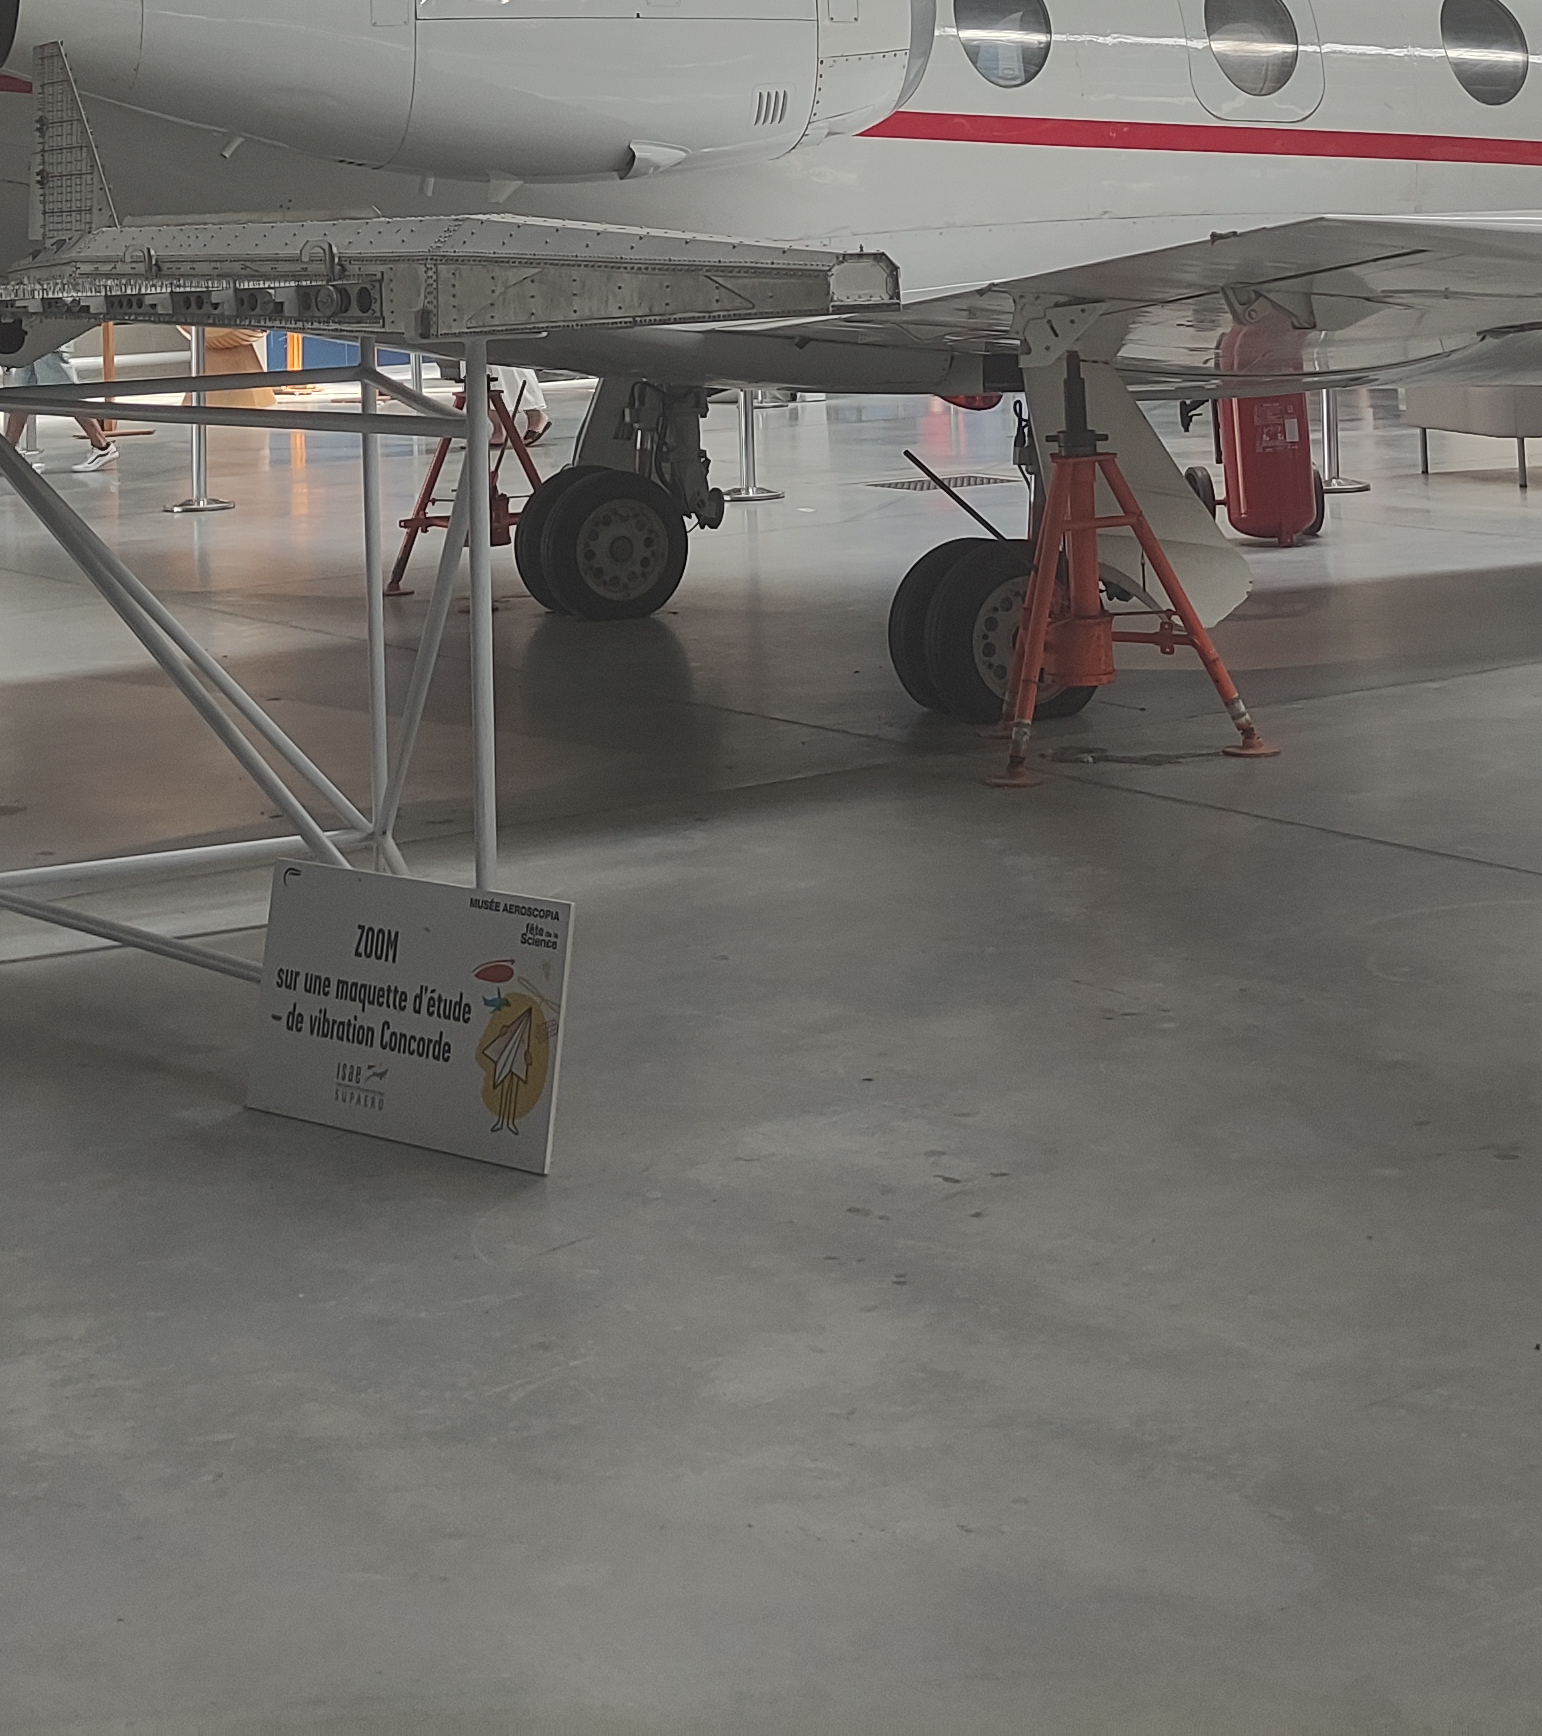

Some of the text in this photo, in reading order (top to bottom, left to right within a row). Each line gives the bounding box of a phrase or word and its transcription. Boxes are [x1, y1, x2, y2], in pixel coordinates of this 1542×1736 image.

[470, 897, 560, 921] MUSÉE AEROSCOPIA
[354, 924, 399, 964] ZOOM
[520, 933, 558, 950] Science
[276, 967, 472, 1024] sur une maquette d'étude
[285, 1002, 452, 1062] de vibration Concorde
